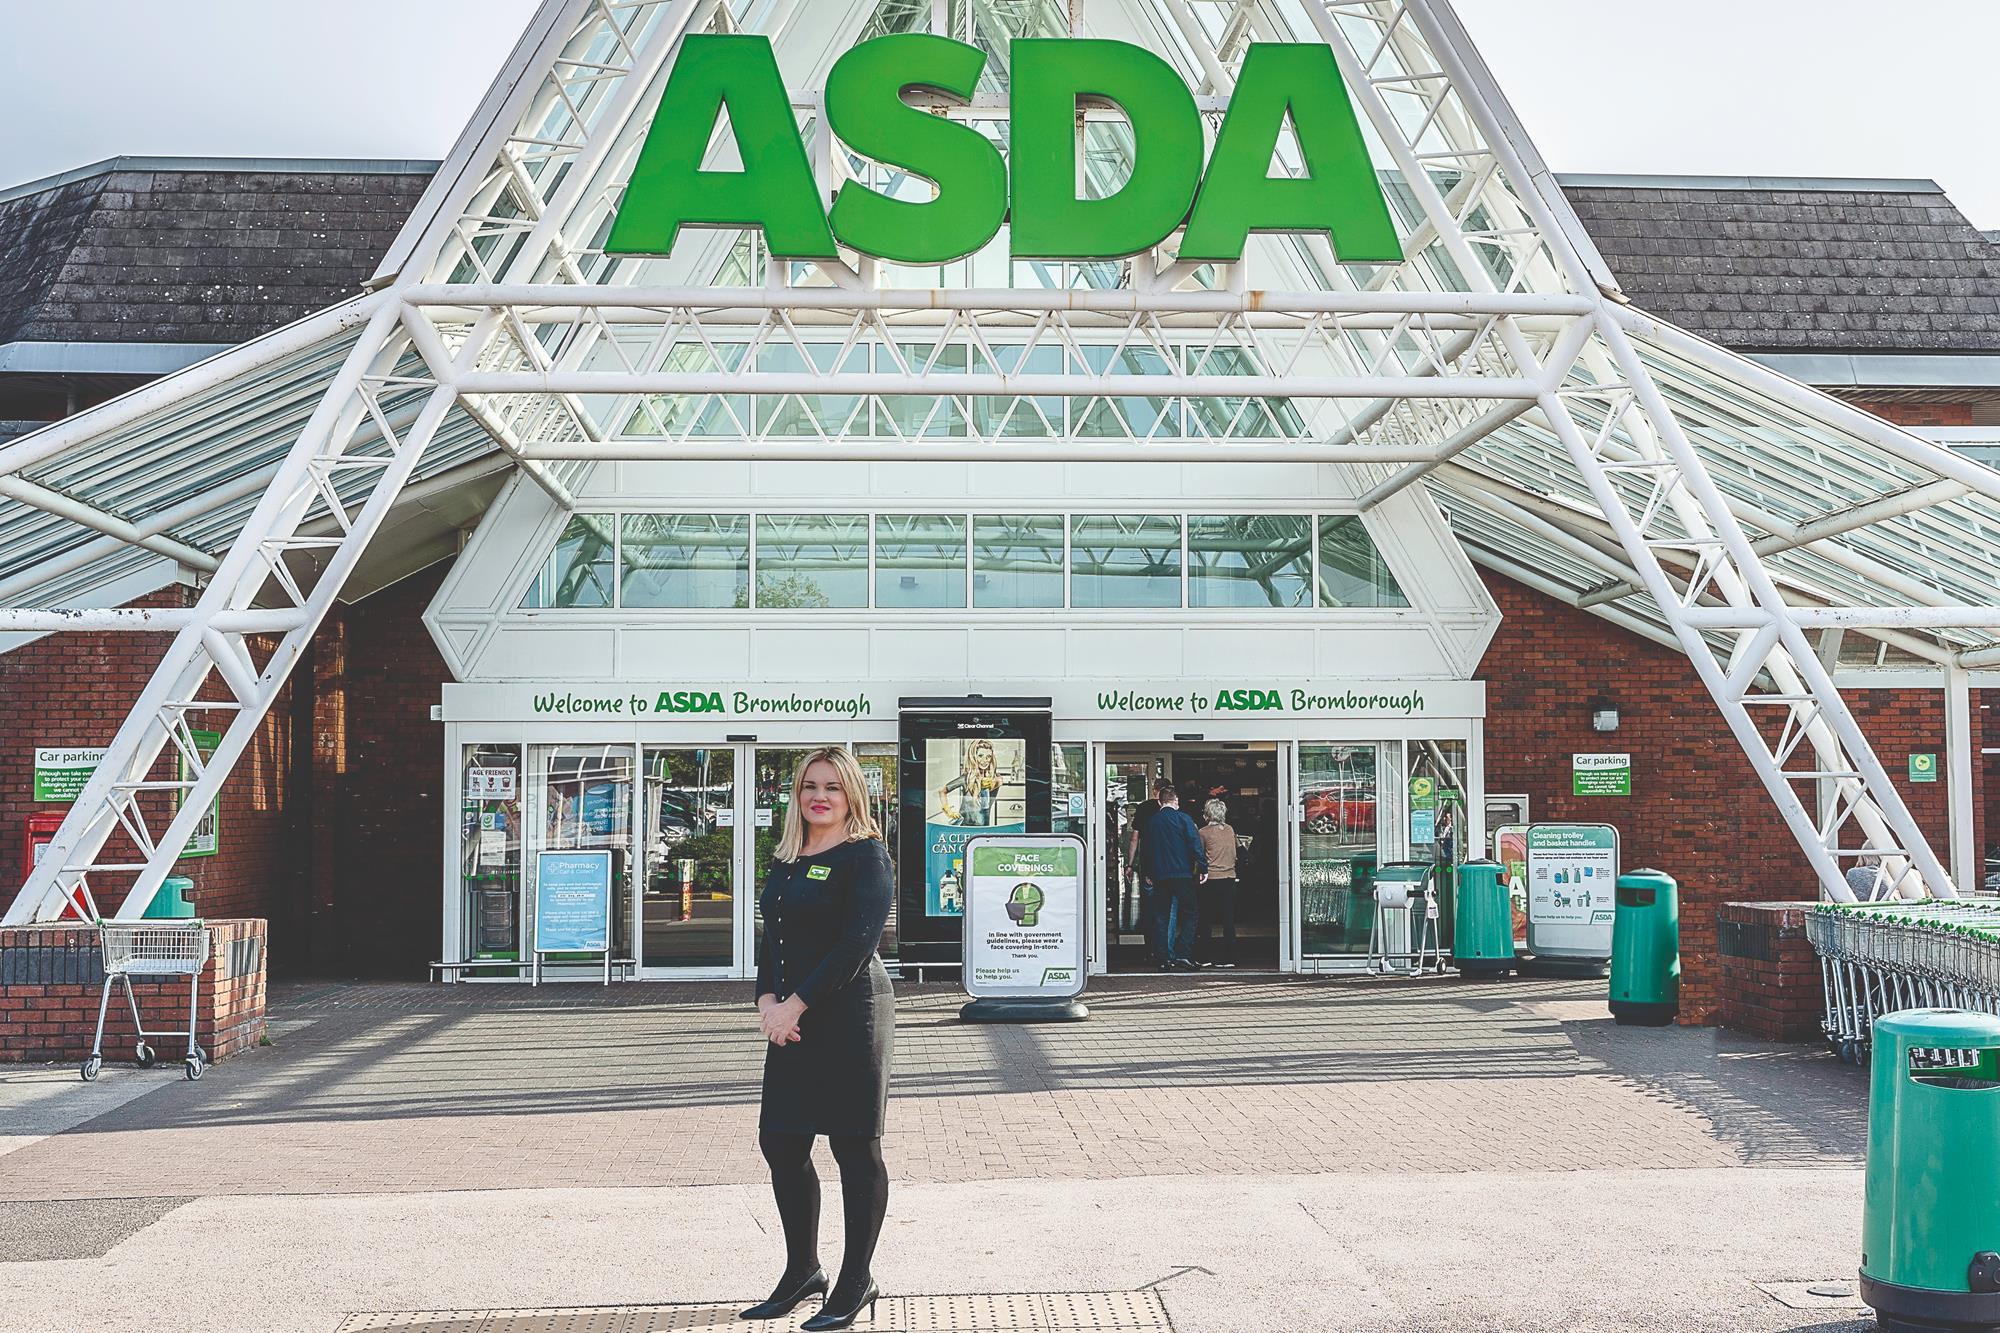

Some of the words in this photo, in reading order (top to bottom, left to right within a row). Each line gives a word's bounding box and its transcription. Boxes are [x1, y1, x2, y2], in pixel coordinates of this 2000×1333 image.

[604, 33, 1404, 265] ASDA
[534, 694, 623, 714] Welcome
[629, 694, 648, 714] to
[654, 692, 726, 713] ASDA
[733, 691, 871, 718] Bromborough
[1097, 691, 1183, 711] Welcome
[1190, 692, 1208, 711] to
[1214, 690, 1283, 711] ASDA
[1291, 690, 1424, 715] Bromborough
[39, 752, 60, 762] Car
[1576, 757, 1592, 765] Car
[1594, 756, 1627, 766] parking
[938, 833, 947, 843] A
[949, 833, 970, 843] CLE
[1532, 832, 1561, 840] Cleaning
[1562, 832, 1584, 840] trolley
[932, 844, 956, 854] CAN
[1014, 854, 1040, 862] FACE
[998, 863, 1054, 872] COVERINGS
[1047, 972, 1070, 980] ASDA
